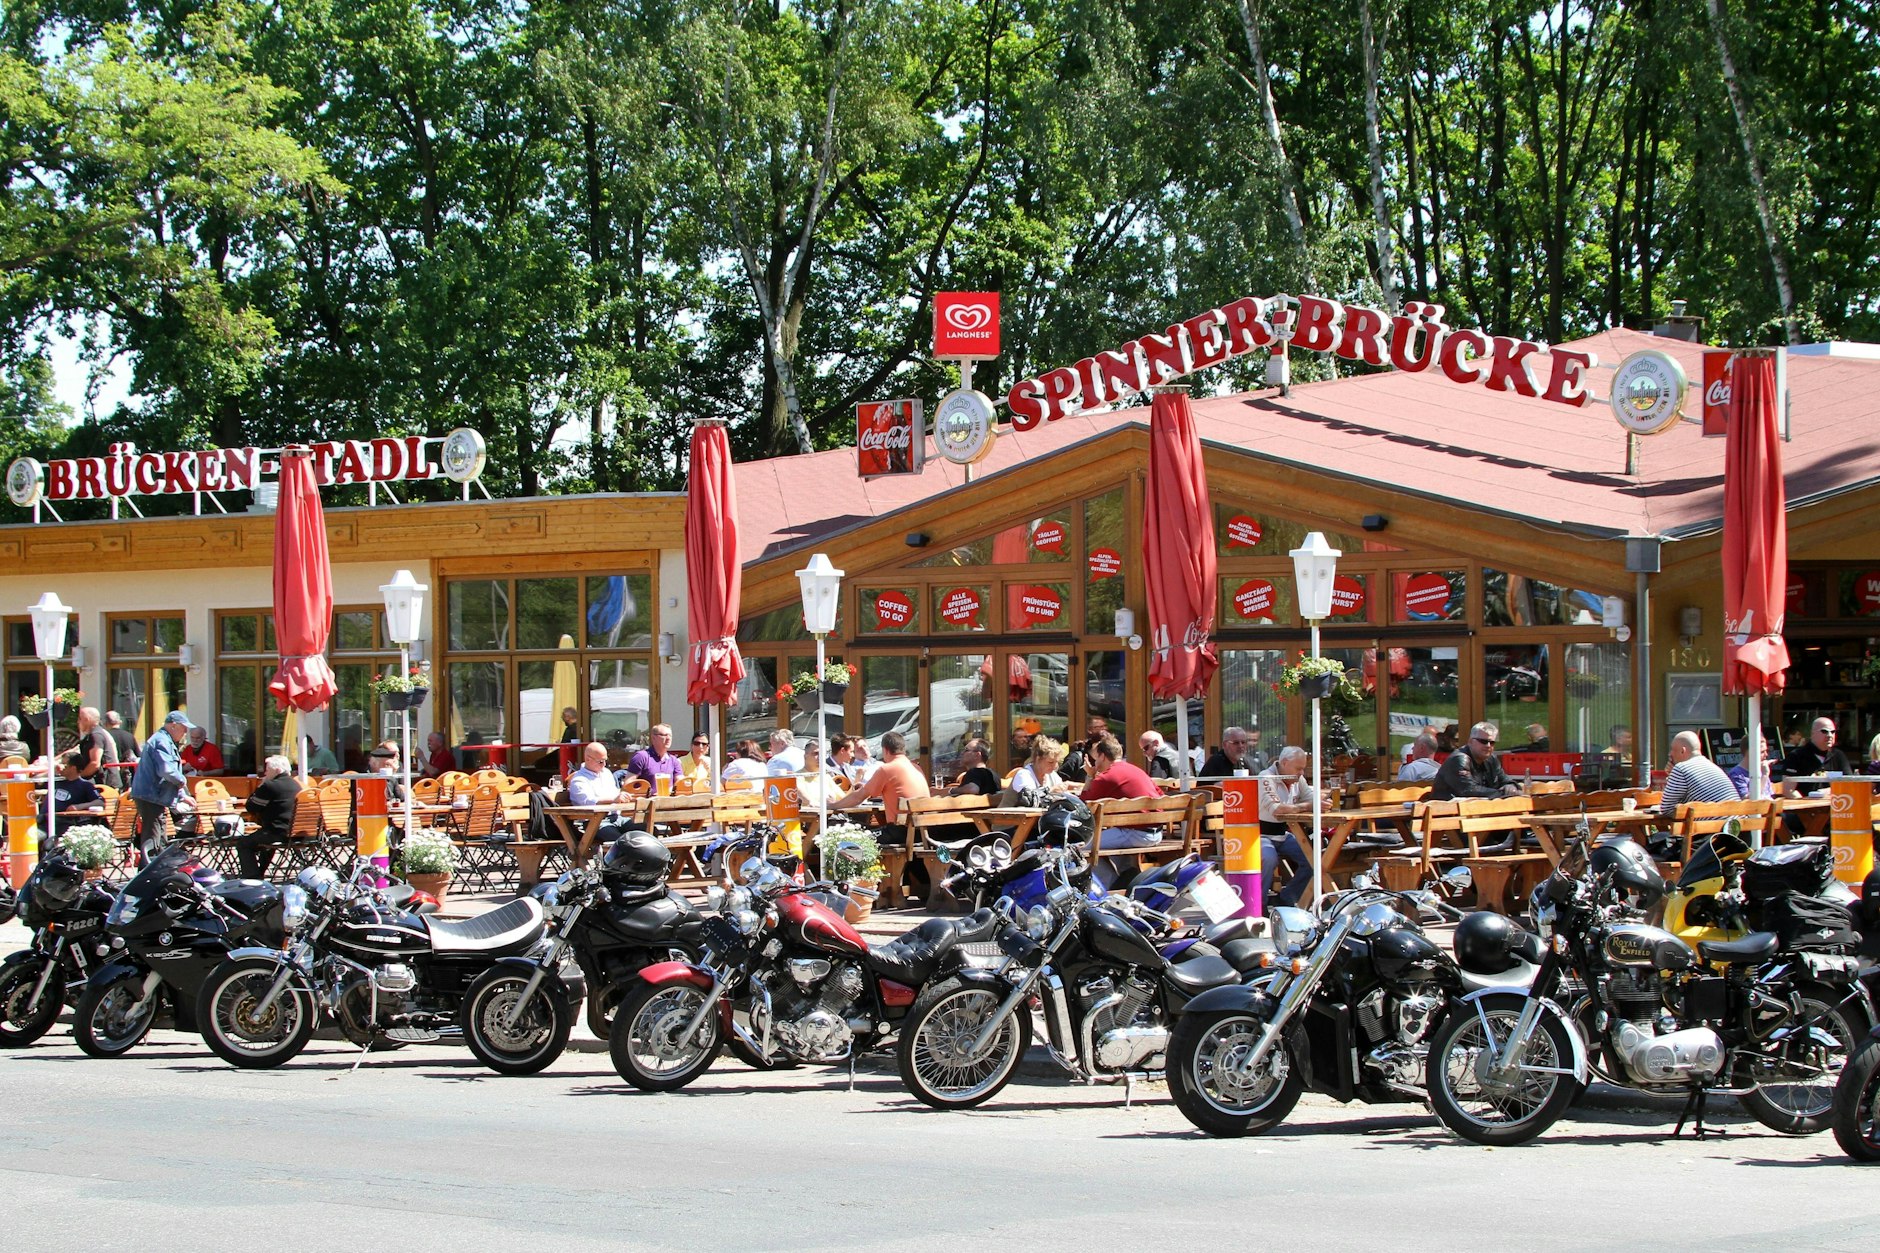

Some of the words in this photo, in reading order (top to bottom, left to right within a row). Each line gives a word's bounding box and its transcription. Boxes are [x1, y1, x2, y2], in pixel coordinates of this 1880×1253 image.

[946, 331, 990, 339] LANGNESE
[860, 424, 912, 451] Coca-Cola
[48, 435, 436, 500] BRÜCKEN-TADL
[1037, 530, 1059, 539] TÄGLICH
[1036, 536, 1062, 546] GEÖFFNET
[951, 592, 966, 601] ALLE
[1235, 585, 1272, 602] GANZTÄGIG
[1332, 590, 1363, 600] STBRAT-
[878, 599, 908, 613] COFFEE
[947, 597, 972, 608] SPEISEN
[1022, 596, 1060, 609] FRÜHSTÜCK
[1243, 594, 1267, 607] WARME
[942, 607, 959, 616] AUCH
[1243, 600, 1270, 614] SPEISEN
[880, 610, 890, 618] TO
[892, 612, 904, 622] GO
[953, 611, 970, 620] HAUS
[1040, 609, 1055, 617] UHR
[66, 916, 99, 931] Fazer
[1612, 936, 1638, 948] ROYAL
[1620, 945, 1651, 956] ENFIELD
